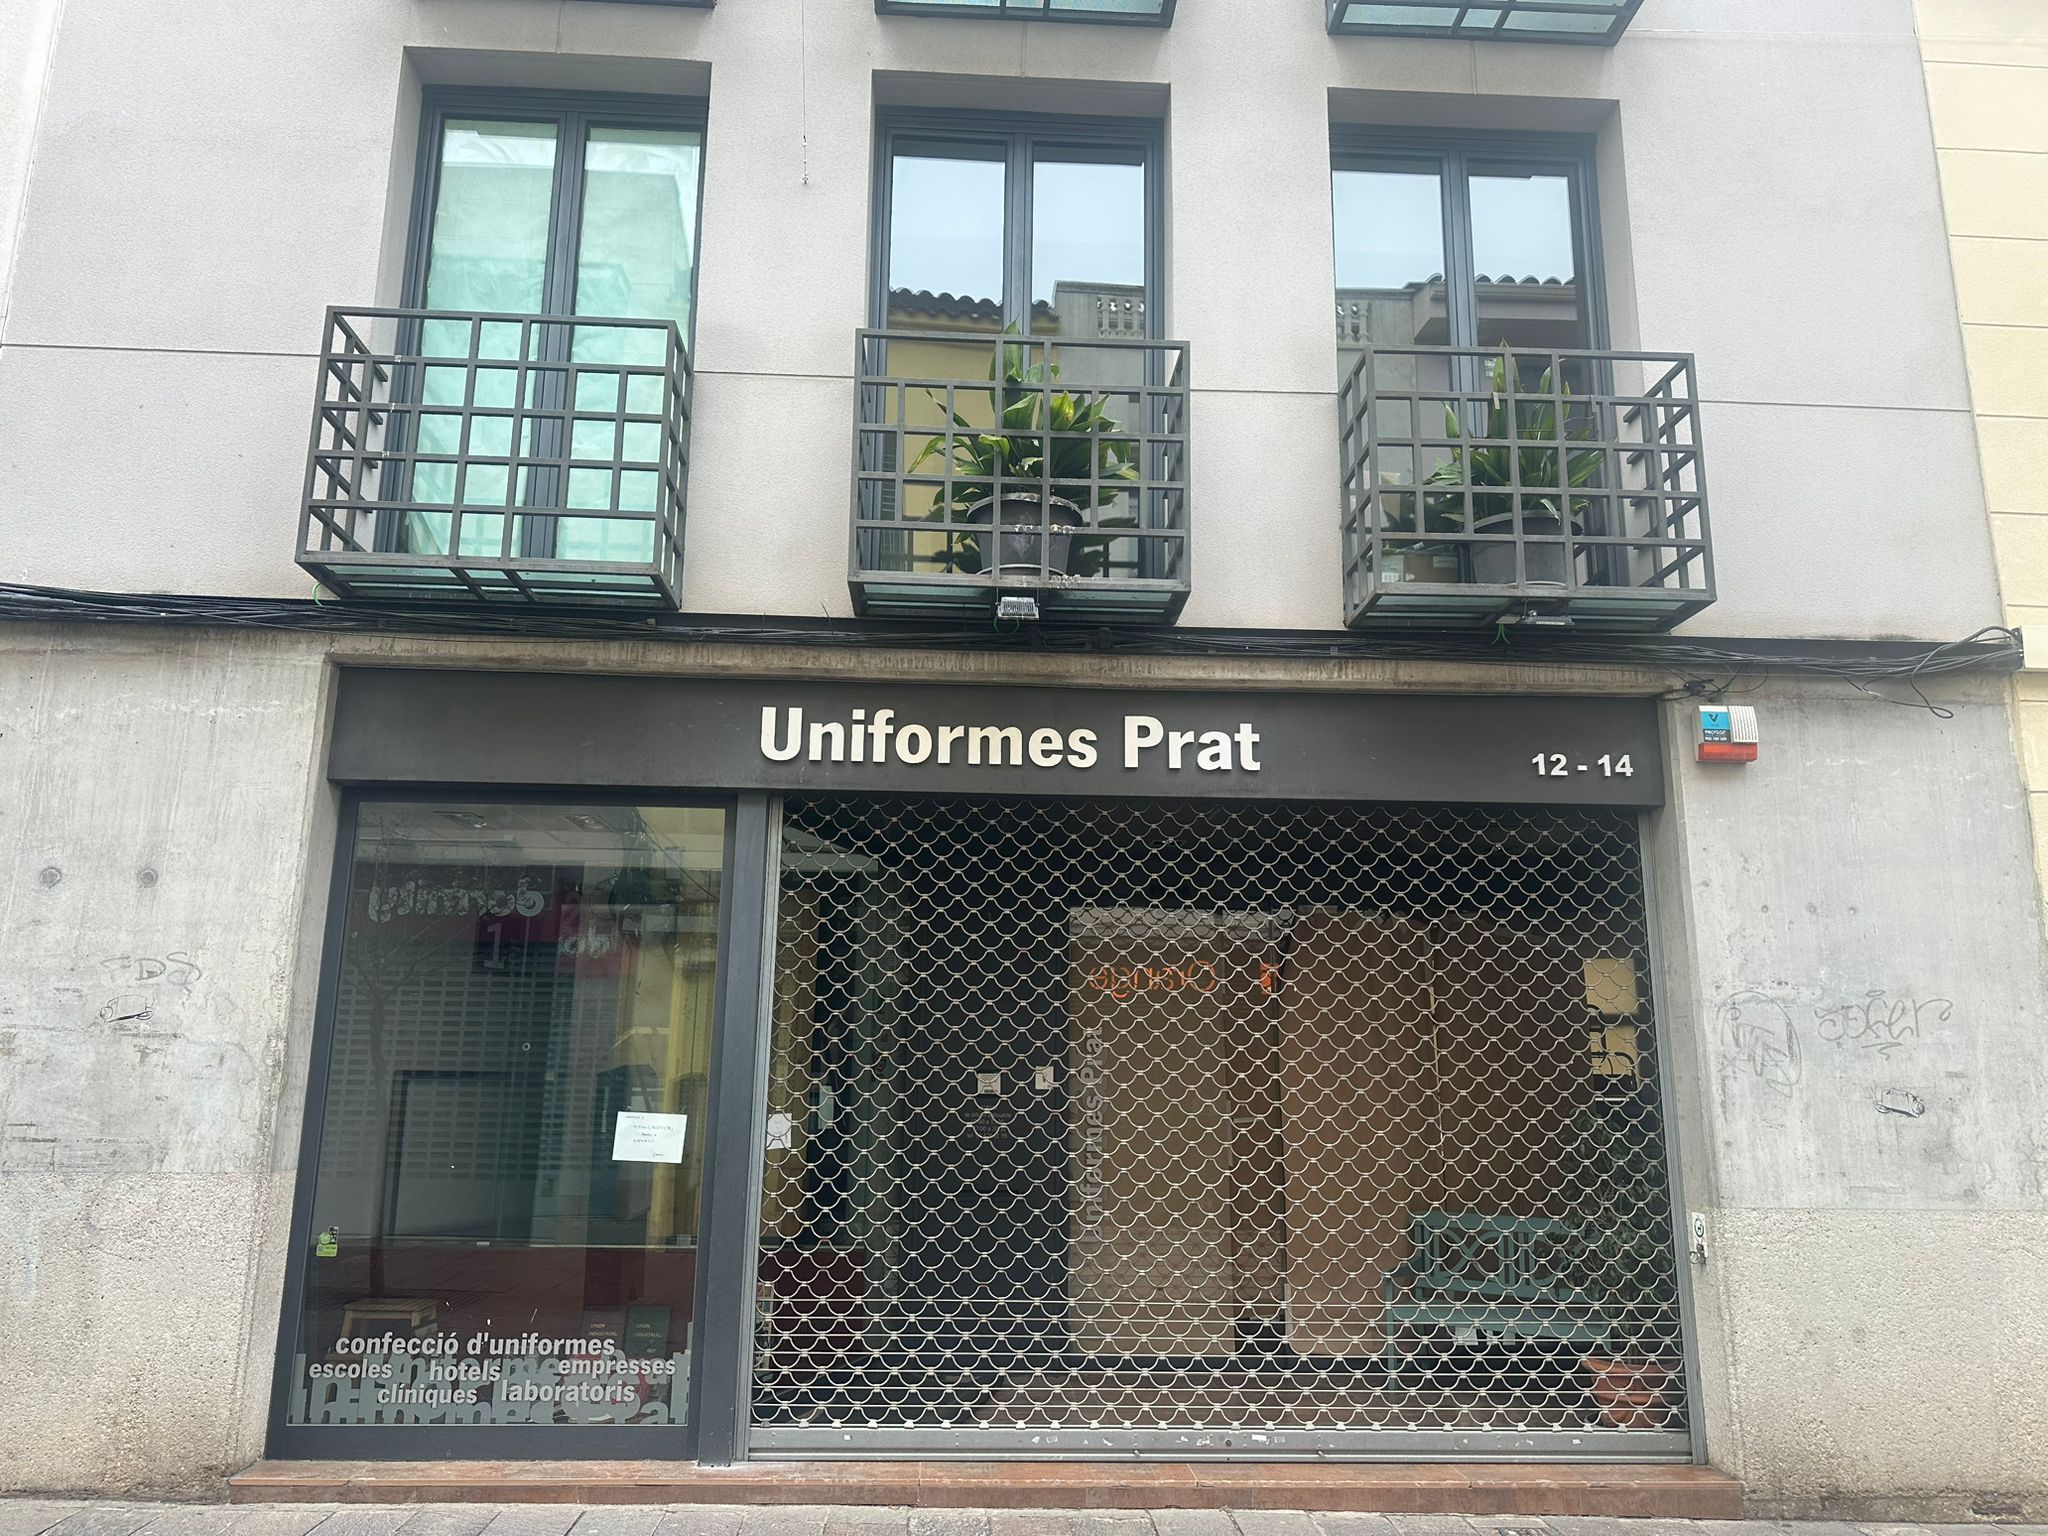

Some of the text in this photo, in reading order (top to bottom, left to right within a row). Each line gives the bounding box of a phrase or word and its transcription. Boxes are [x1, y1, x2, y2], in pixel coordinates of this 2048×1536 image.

[760, 706, 1262, 772] Uniformes Prat
[1531, 753, 1569, 776] 12
[1597, 754, 1634, 777] 14
[335, 1331, 616, 1356] confecció d'uniformes
[308, 1358, 677, 1382] escoles hotels empresses
[377, 1379, 636, 1409] clíniques laboratoris
